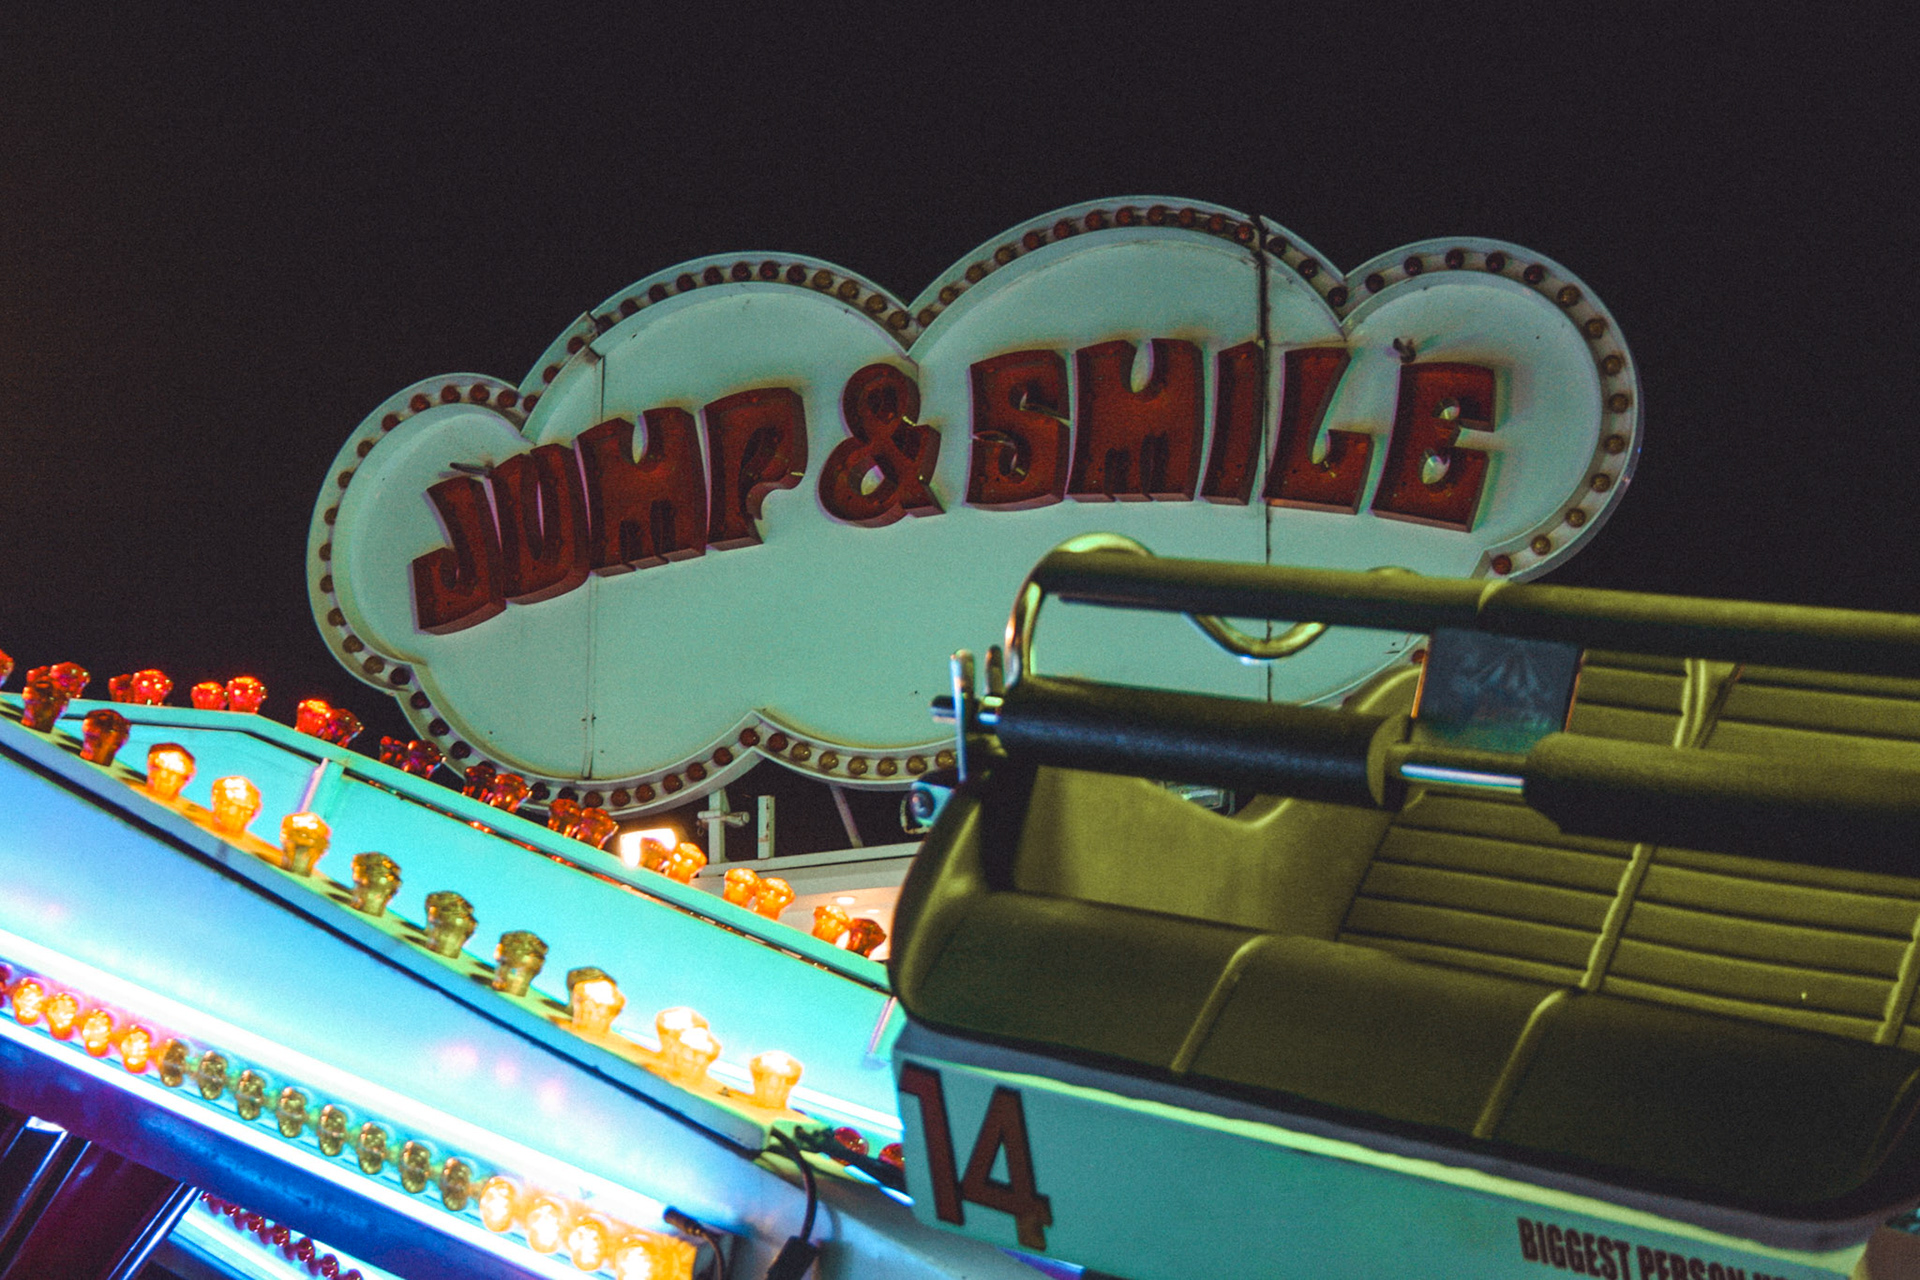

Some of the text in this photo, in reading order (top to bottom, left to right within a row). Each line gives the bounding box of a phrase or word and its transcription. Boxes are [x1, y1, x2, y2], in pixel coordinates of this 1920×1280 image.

[411, 338, 1497, 635] JUMP & SMILE
[899, 1060, 1053, 1252] 14
[1517, 1217, 1631, 1280] BIGGEST
